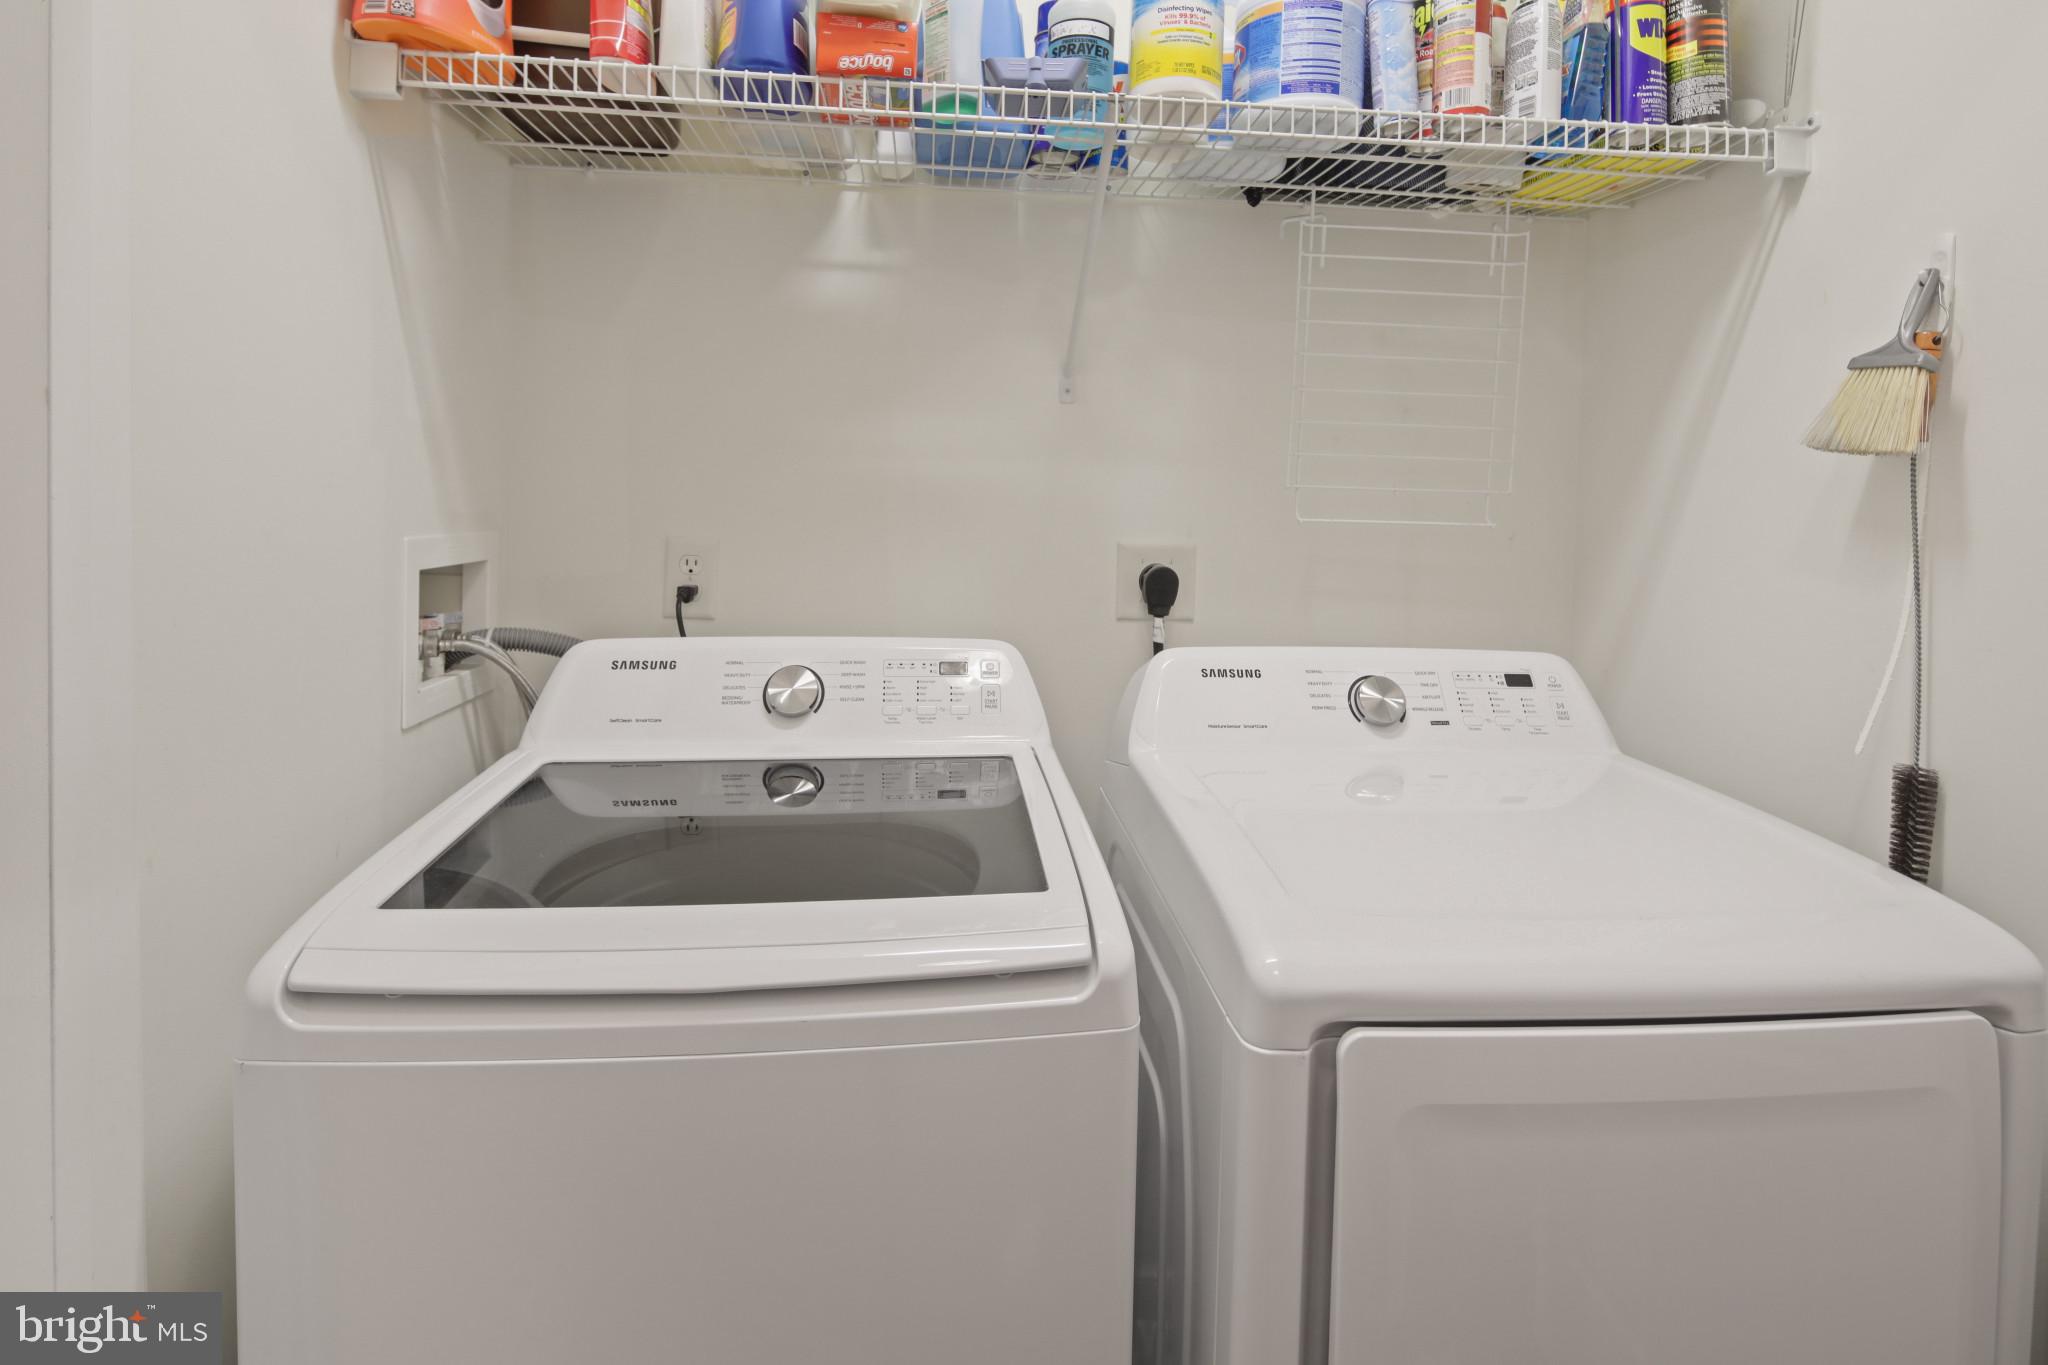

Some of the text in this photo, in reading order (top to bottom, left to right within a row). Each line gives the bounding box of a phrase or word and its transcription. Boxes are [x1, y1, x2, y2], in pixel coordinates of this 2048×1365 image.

[1158, 5, 1194, 13] Disinfecting
[1052, 42, 1110, 60] SPRAYER
[838, 52, 894, 72] bounce
[611, 660, 677, 670] SAMSUNG
[1201, 668, 1262, 679] SAMSUNG
